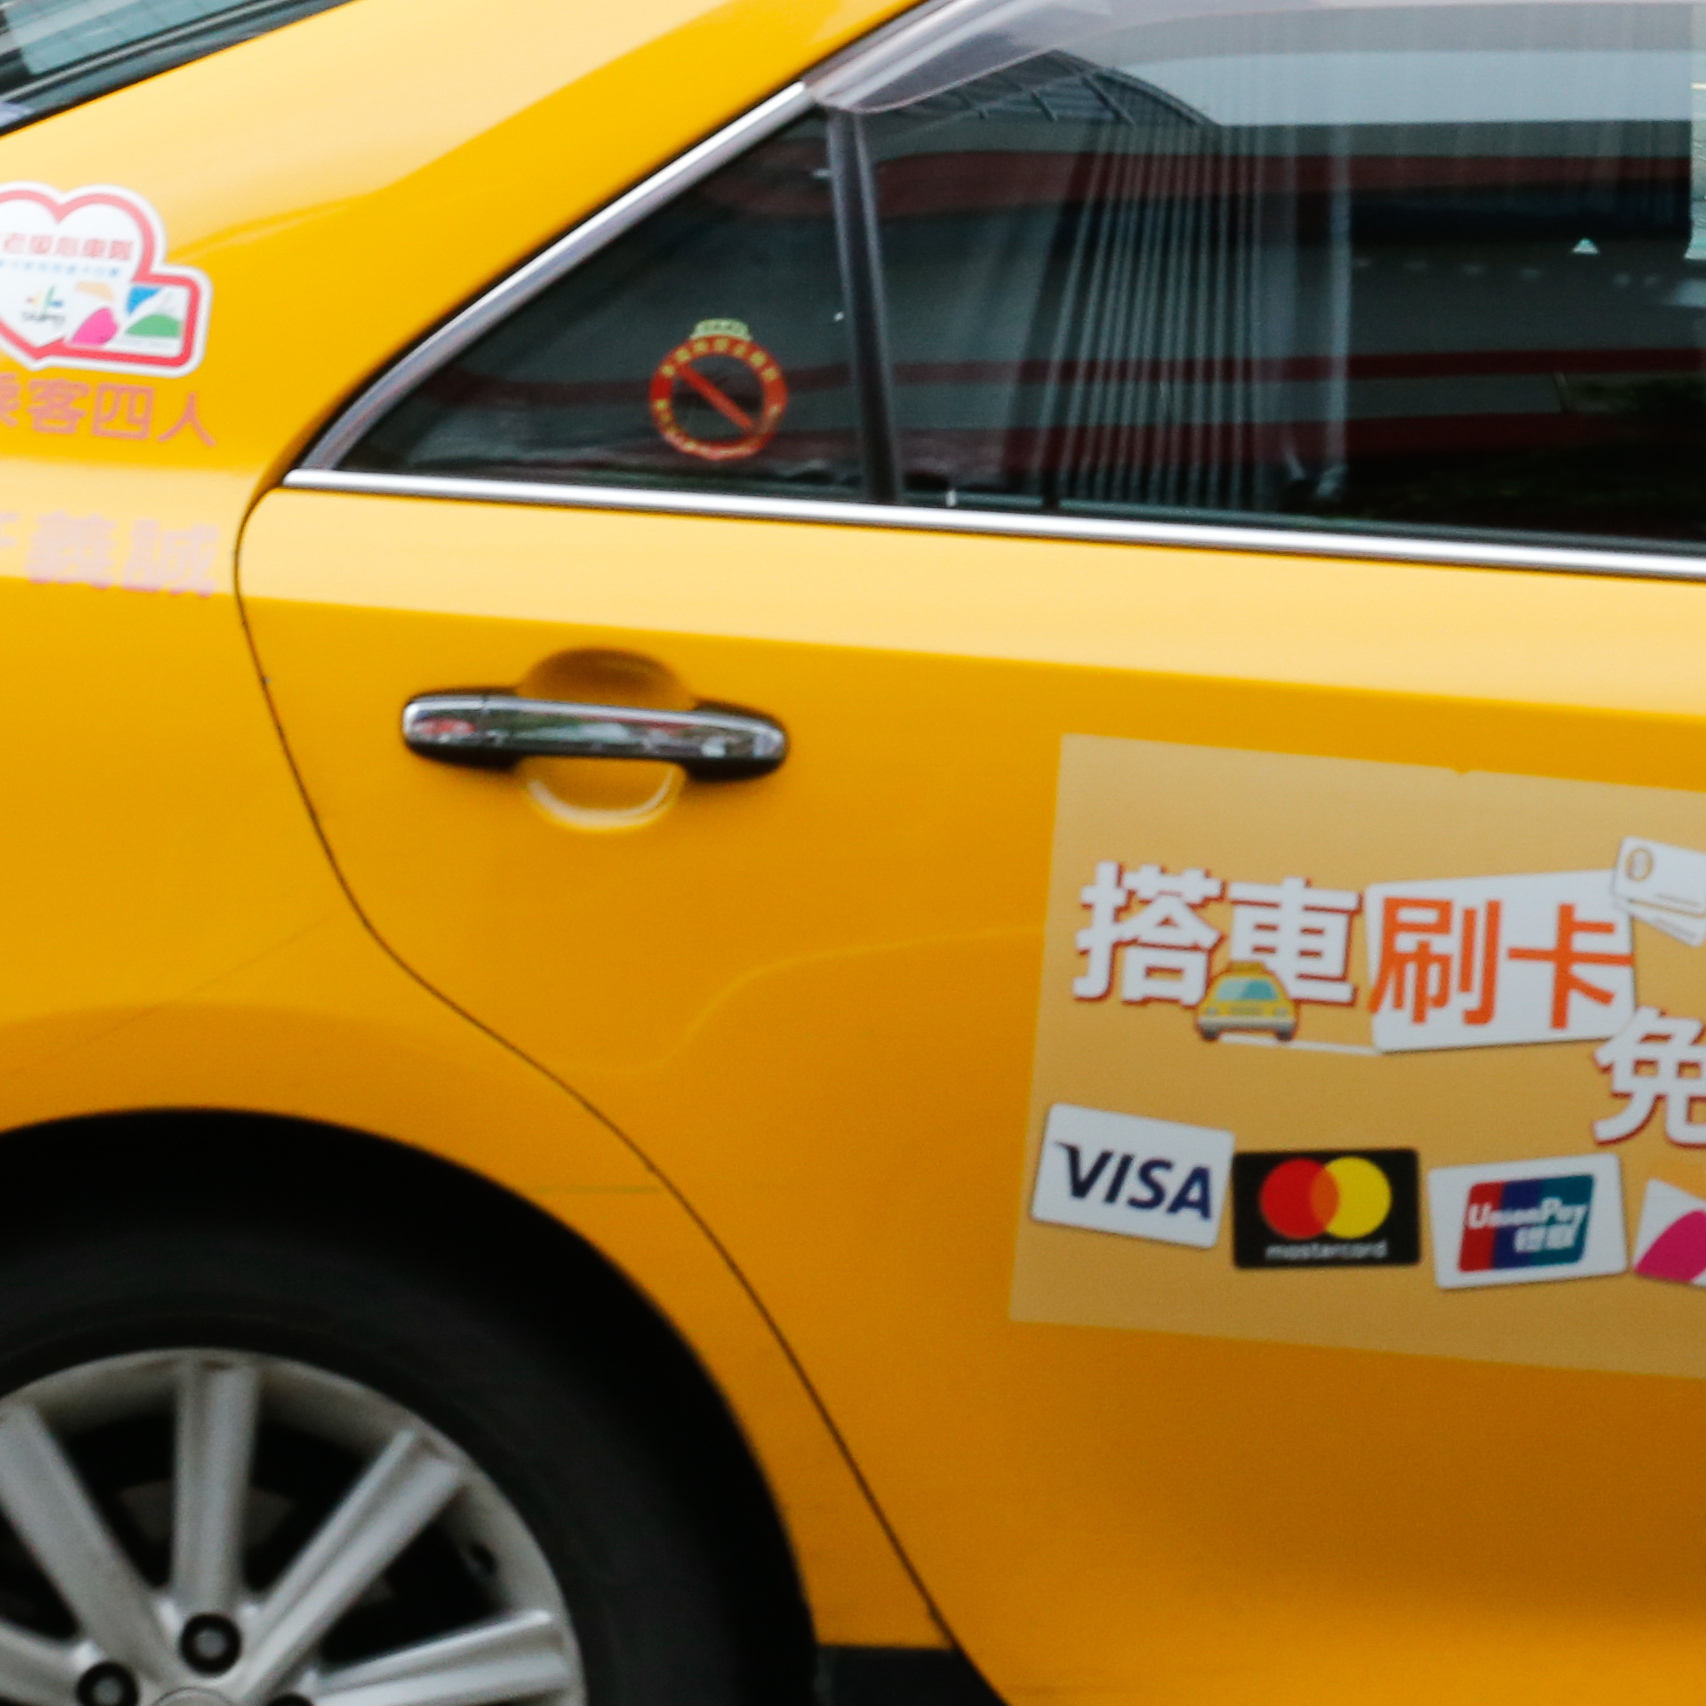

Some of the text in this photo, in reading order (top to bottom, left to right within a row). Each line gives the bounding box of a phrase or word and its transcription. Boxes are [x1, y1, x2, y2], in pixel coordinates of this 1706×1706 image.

[1072, 860, 1634, 1030] 搭車刷卡
[1054, 1140, 1213, 1221] VISA
[1264, 1239, 1389, 1262] mastercard
